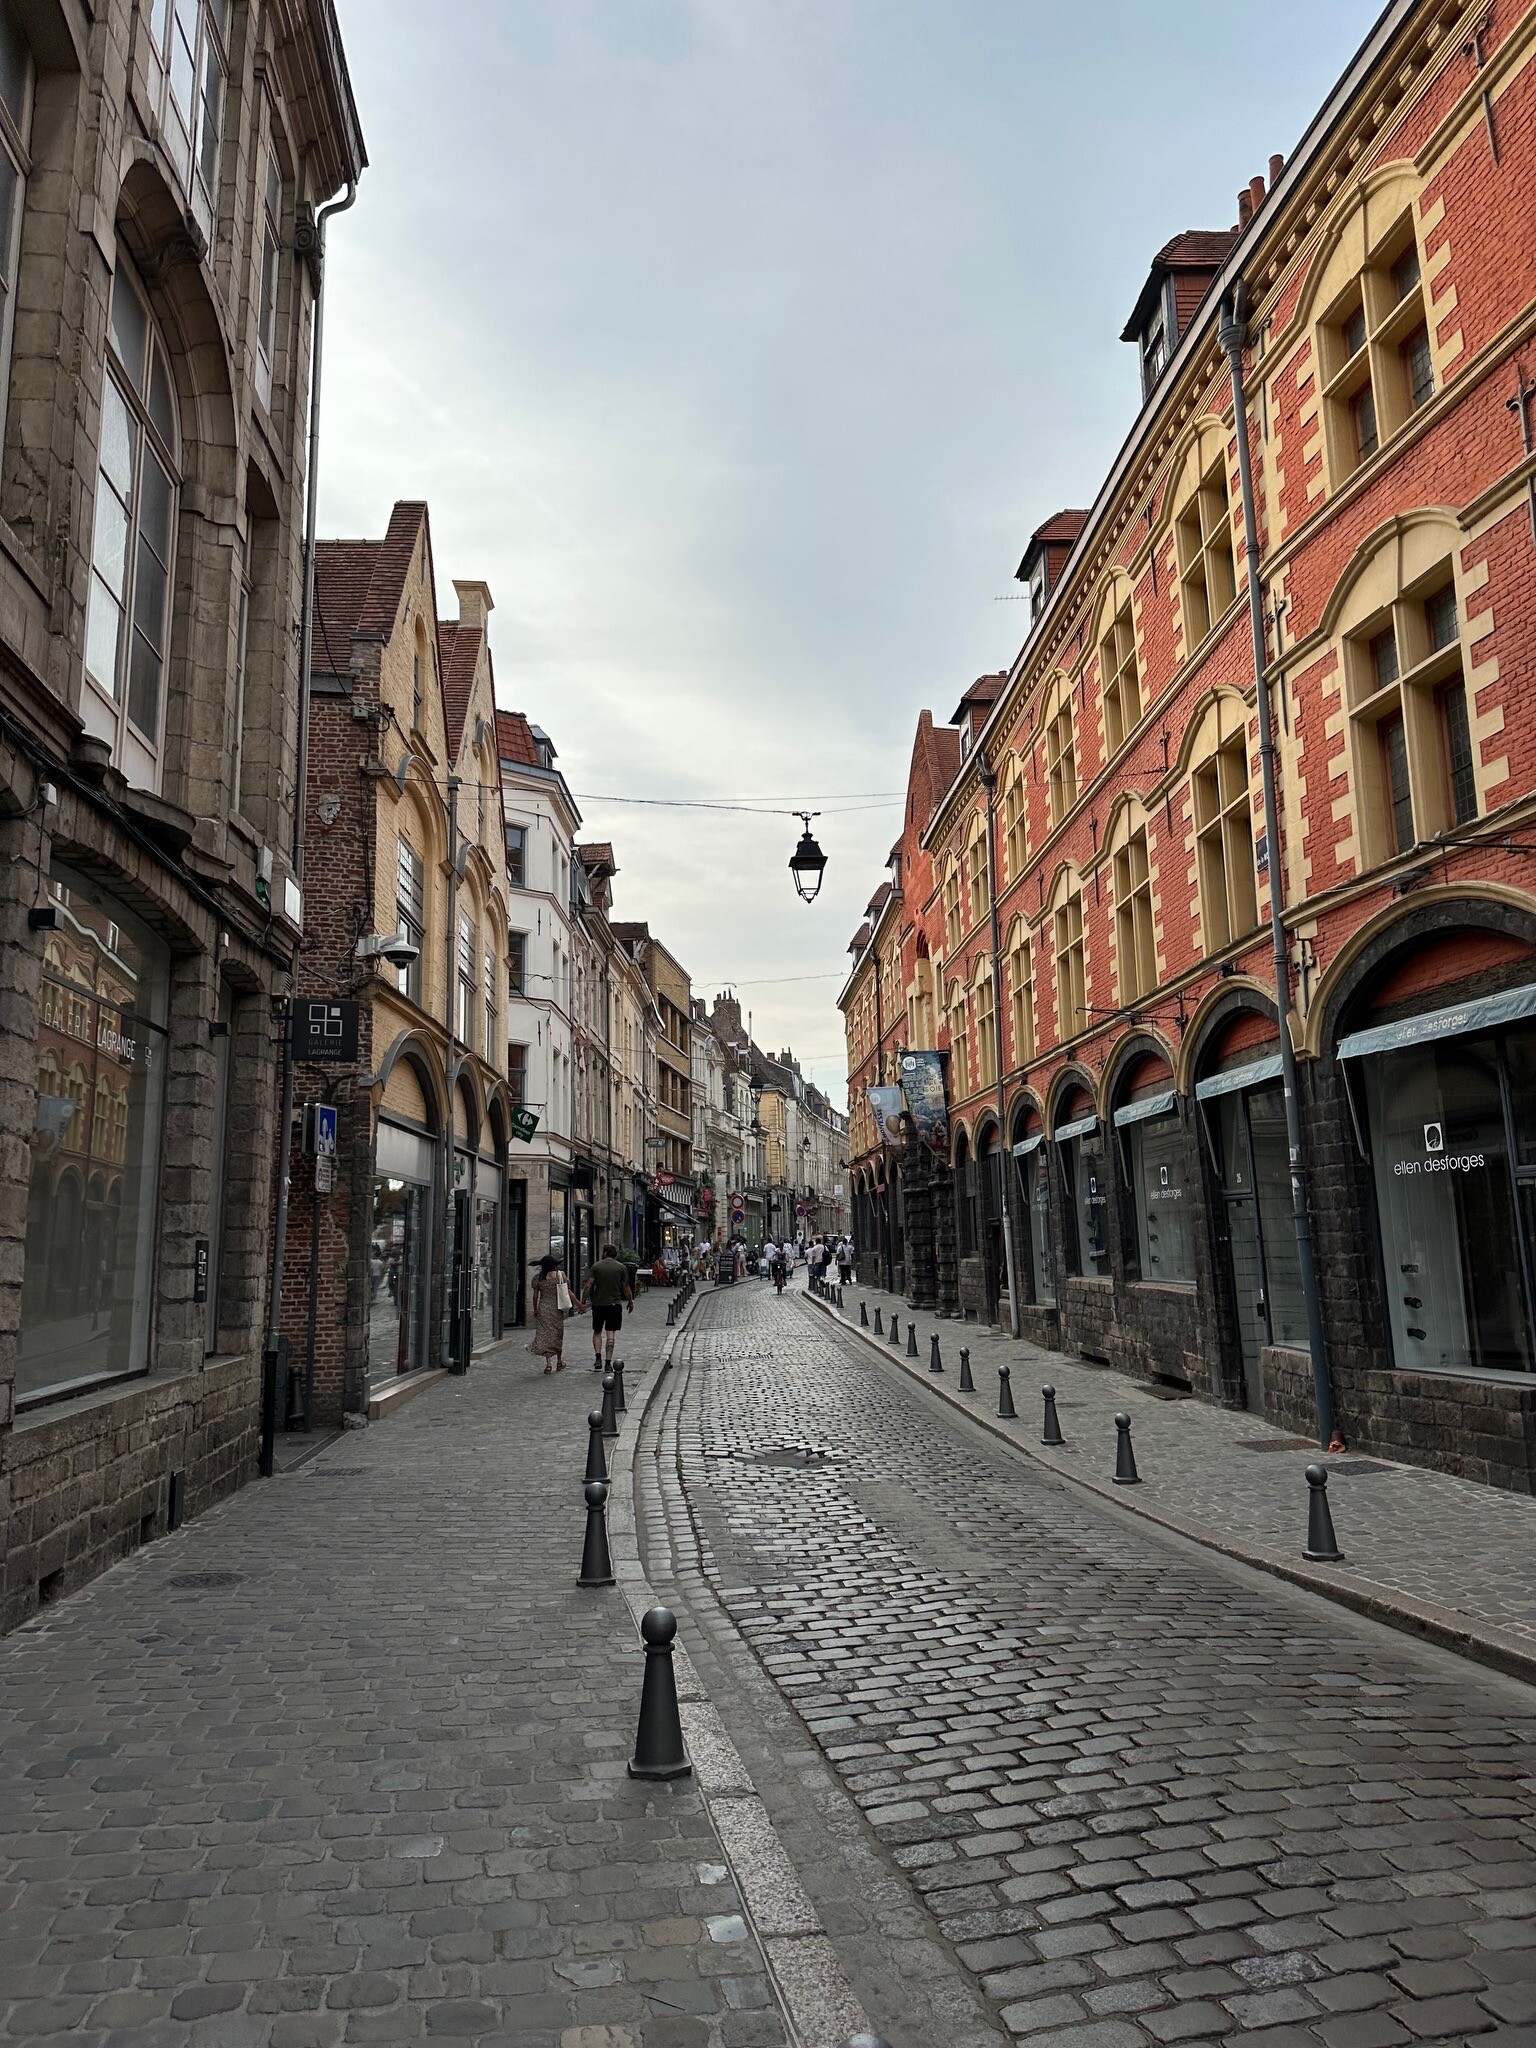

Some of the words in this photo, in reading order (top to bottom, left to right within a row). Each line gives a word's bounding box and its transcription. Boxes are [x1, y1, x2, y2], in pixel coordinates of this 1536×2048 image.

[44, 1002, 91, 1043] GALERIE
[97, 1024, 136, 1061] LAGRANGE
[1394, 1160, 1421, 1175] ellen
[1424, 1154, 1485, 1172] desforges
